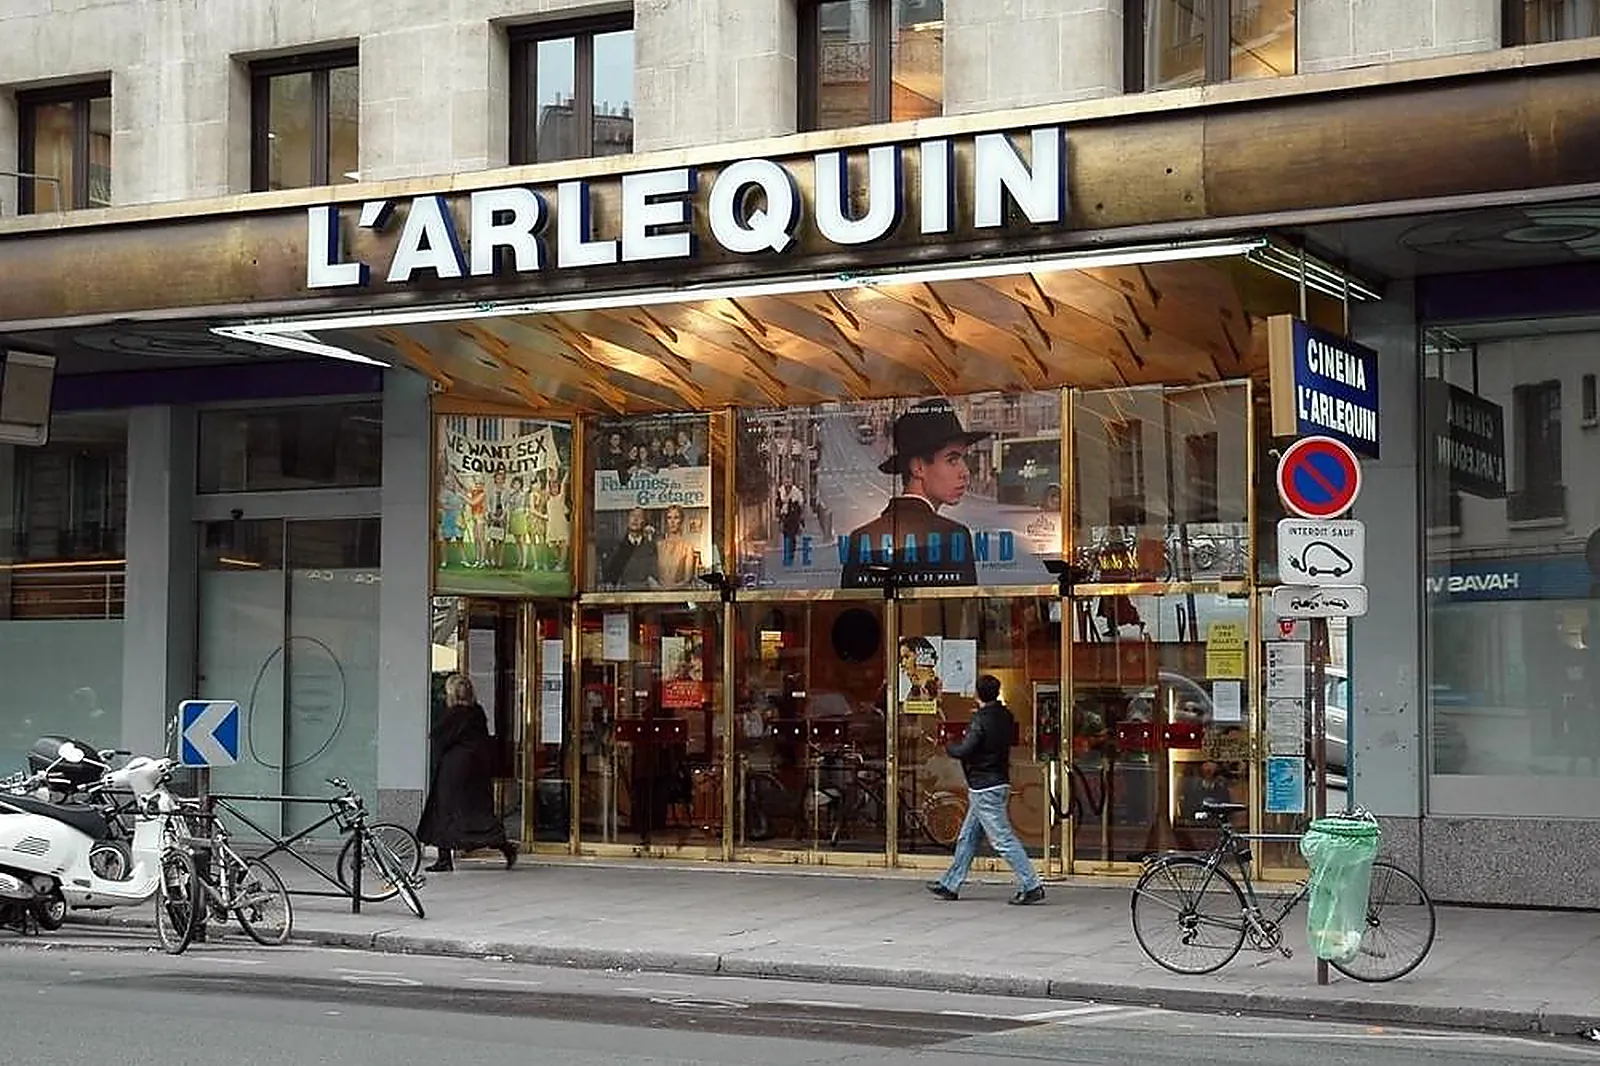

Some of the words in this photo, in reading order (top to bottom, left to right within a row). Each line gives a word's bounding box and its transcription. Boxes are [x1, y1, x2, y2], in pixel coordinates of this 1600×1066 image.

[307, 126, 1064, 290] L'ARLEQUIN
[1307, 338, 1366, 391] CINEMA
[1298, 385, 1376, 442] L'ARLEQUIN
[462, 455, 539, 474] EQUALITY
[467, 441, 512, 460] WANT
[517, 435, 547, 457] SEX
[838, 530, 1015, 565] VAGABOND
[1289, 526, 1328, 537] INTERDIT
[1332, 526, 1354, 538] SAUF
